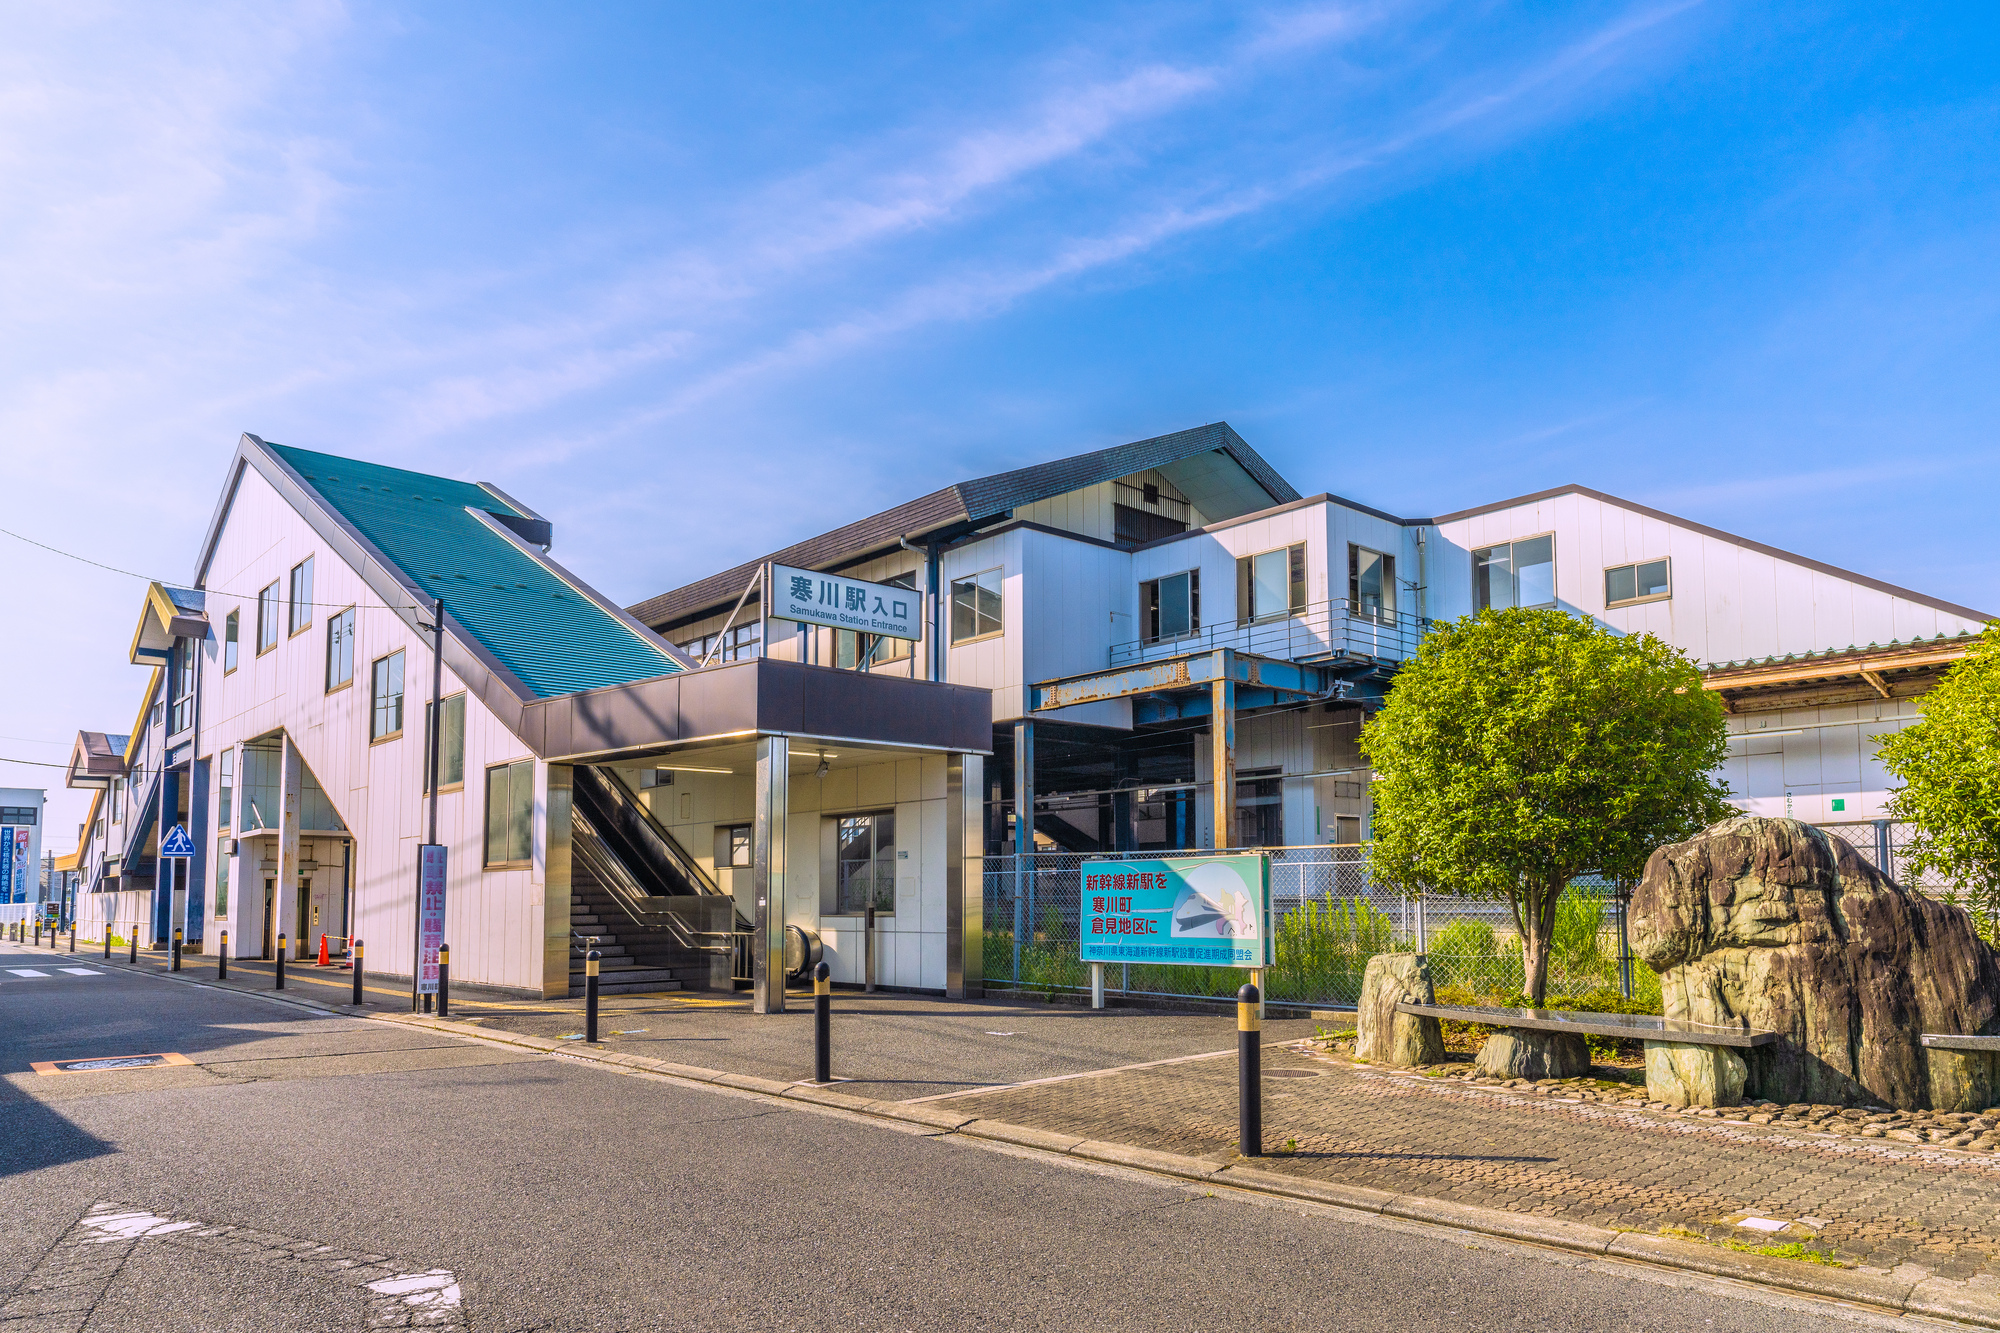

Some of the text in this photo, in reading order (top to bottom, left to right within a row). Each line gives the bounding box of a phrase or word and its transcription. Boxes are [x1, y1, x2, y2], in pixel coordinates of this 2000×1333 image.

[790, 575, 907, 620] 寒川駅入口
[789, 604, 907, 632] Samukawa Station Entrance
[1085, 872, 1168, 891] 新幹線新駅を
[1092, 896, 1133, 913] 寒川町
[1091, 917, 1158, 935] 倉見地区に
[1088, 946, 1253, 961] 神奈川県東海道新幹線新駅設置促進期成同盟会
